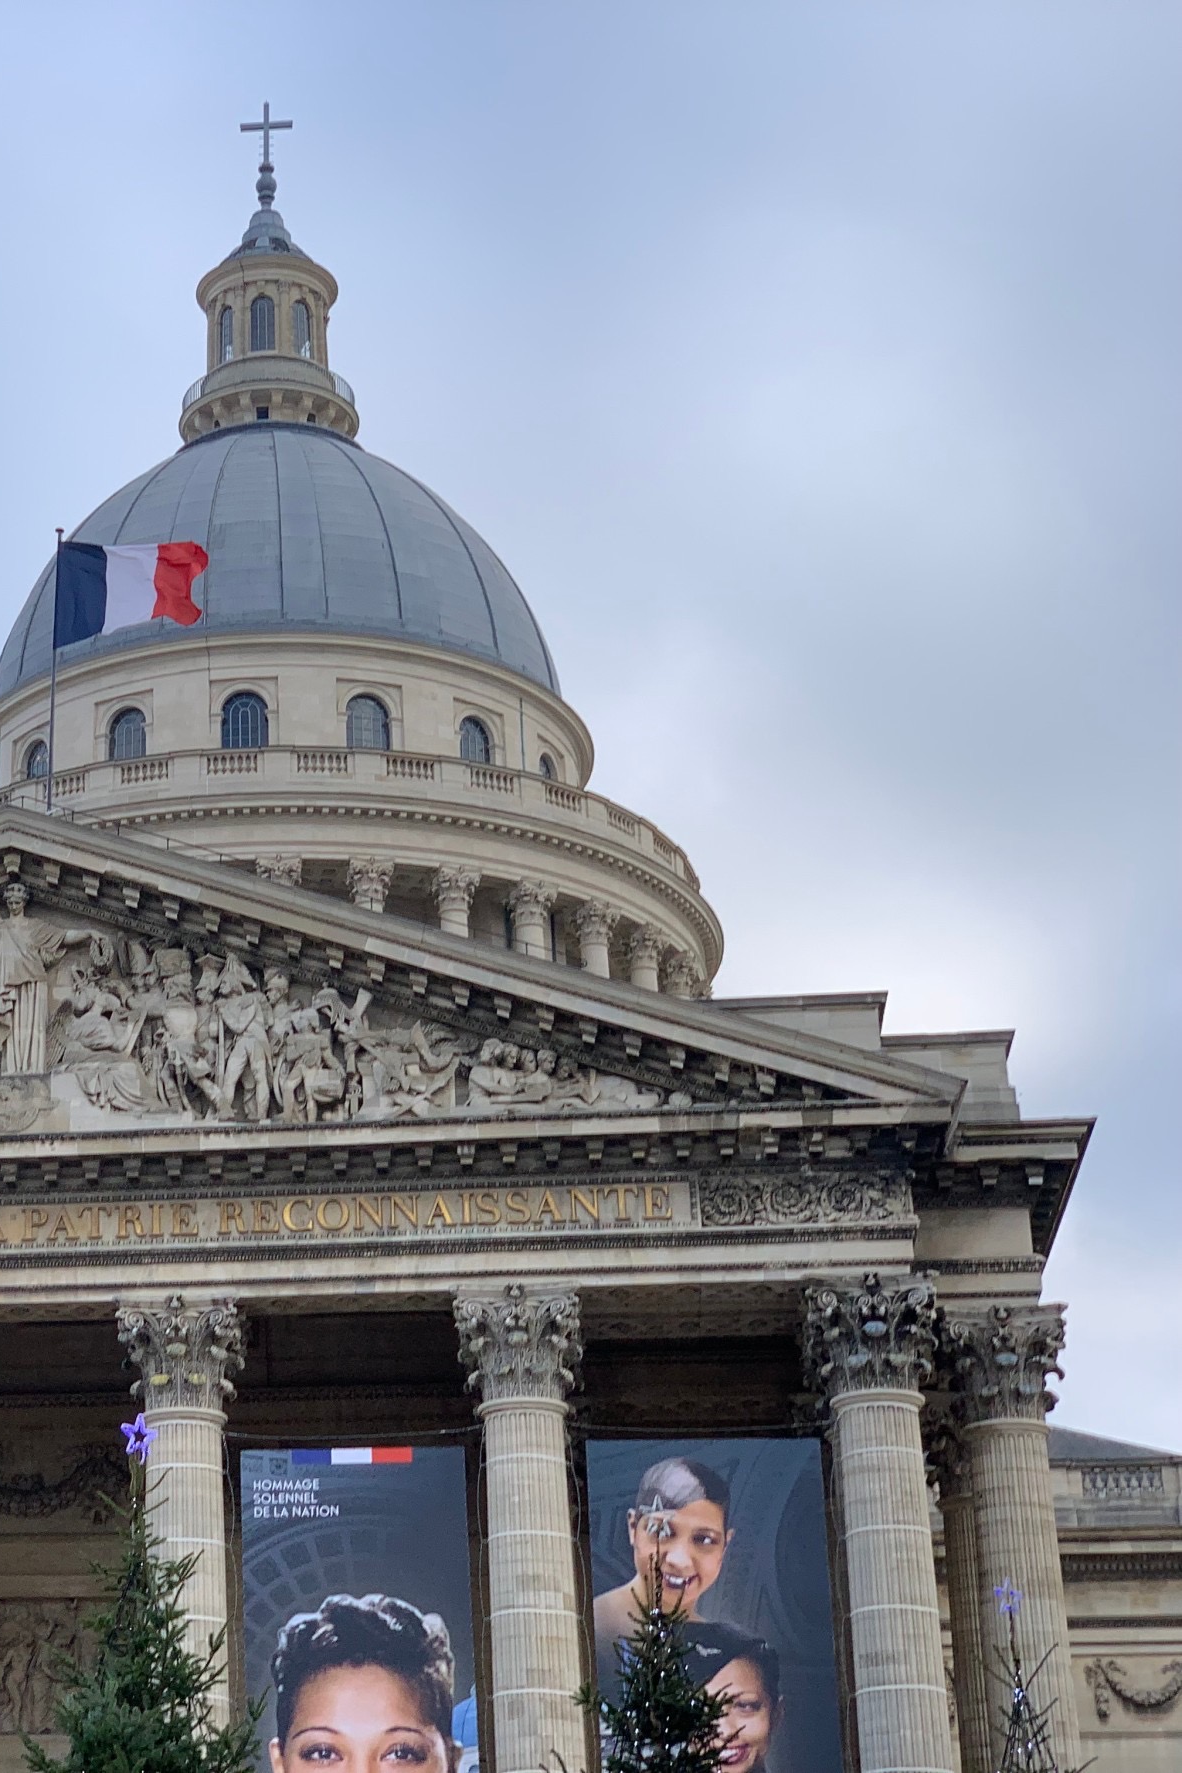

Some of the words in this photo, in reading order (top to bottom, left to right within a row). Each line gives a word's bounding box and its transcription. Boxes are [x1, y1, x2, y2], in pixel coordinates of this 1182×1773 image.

[21, 1203, 199, 1240] PATRIE
[218, 1184, 674, 1235] RECONNAISSANTE
[253, 1479, 320, 1491] HOMMAGE
[253, 1492, 318, 1505] SOLENNEL
[253, 1505, 270, 1518] DE
[273, 1505, 289, 1518] LA
[292, 1504, 340, 1517] NATION
